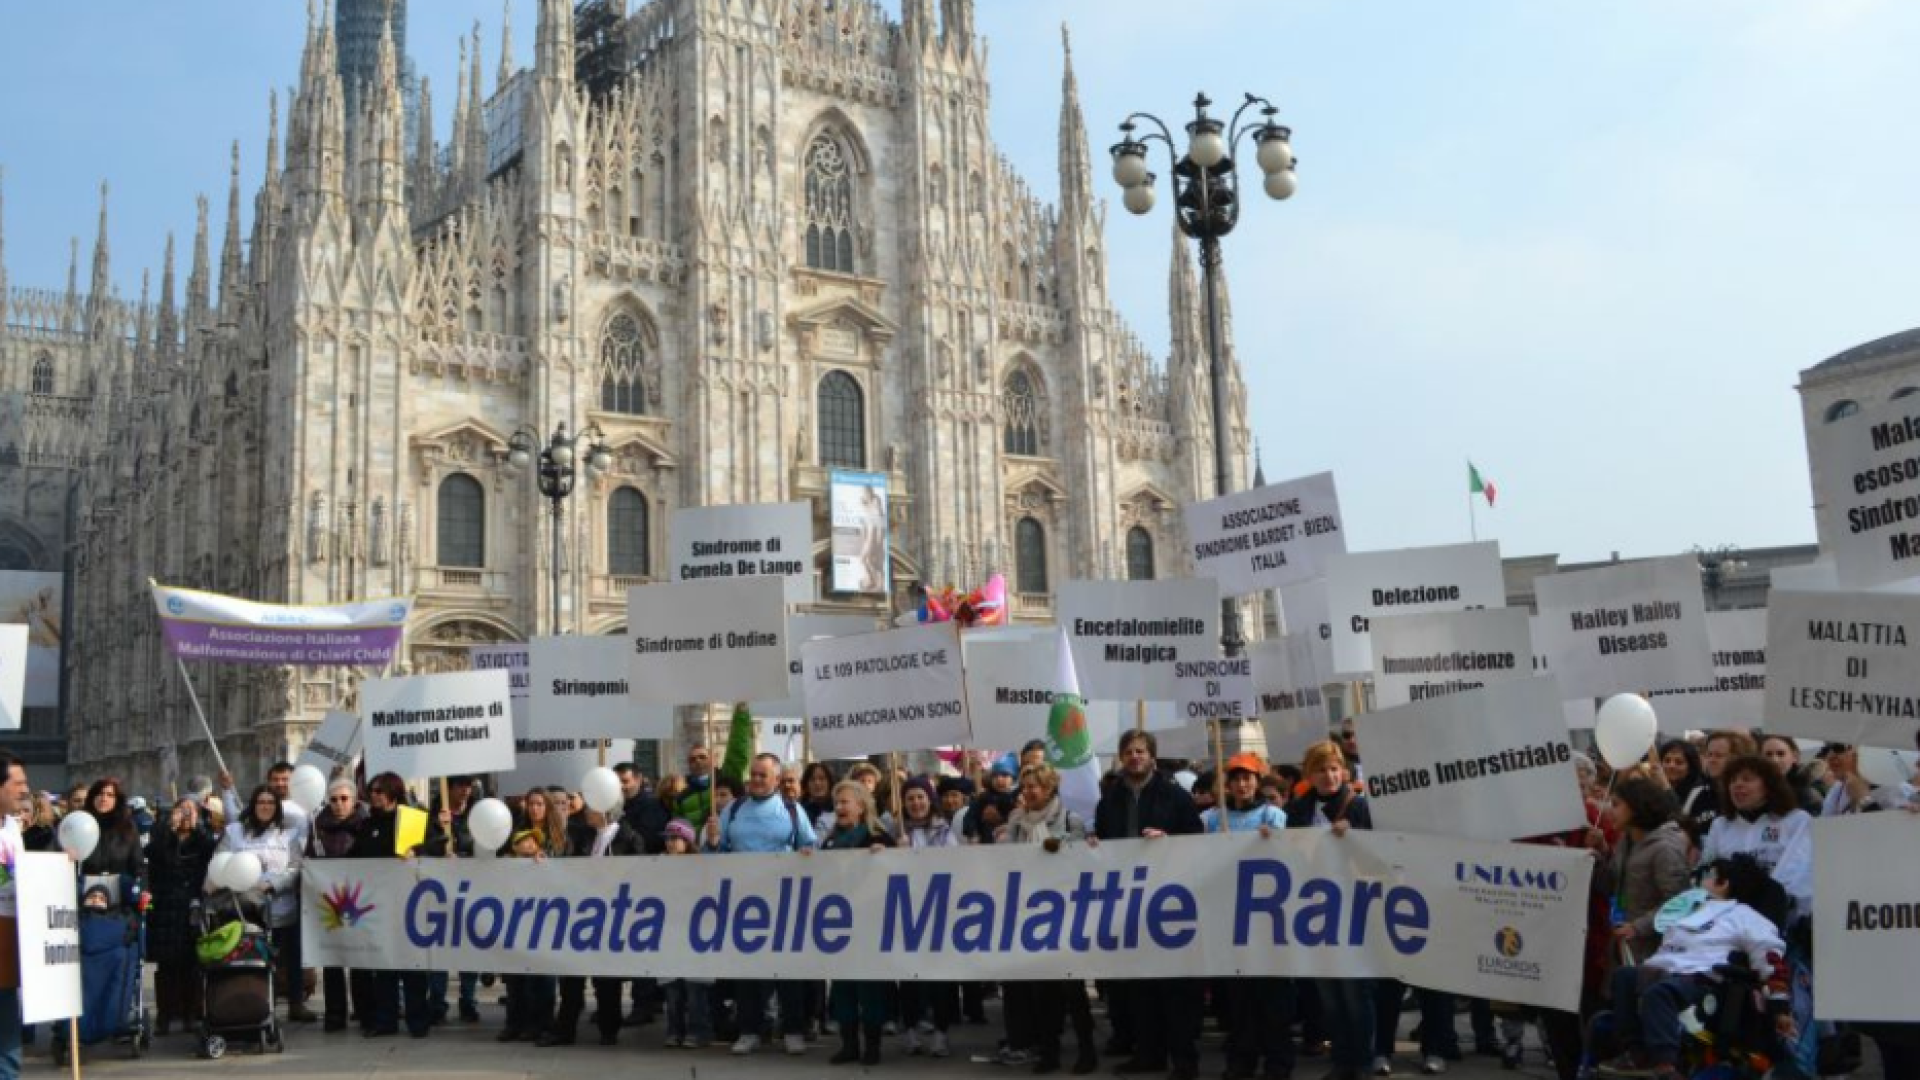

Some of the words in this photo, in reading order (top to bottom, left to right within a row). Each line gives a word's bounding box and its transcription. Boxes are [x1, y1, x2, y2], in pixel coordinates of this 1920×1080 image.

[1222, 498, 1301, 529] ASSOCIAZIONE
[692, 538, 762, 557] Sindrome
[766, 536, 781, 550] di
[1195, 533, 1251, 560] SINDROME
[1252, 524, 1295, 547] BARDET
[738, 559, 756, 575] De
[760, 558, 803, 576] Lange
[1251, 551, 1287, 572] ITALIA
[1372, 584, 1460, 606] Delezione
[1075, 618, 1205, 637] Encefalomielite
[1570, 608, 1628, 631] Hailey
[1631, 601, 1681, 623] Hailey
[208, 626, 305, 645] Associazione
[306, 631, 361, 646] Italiana
[636, 635, 704, 654] Sindrome
[708, 632, 722, 648] di
[726, 630, 777, 648] Ondine
[1599, 631, 1668, 655] Disease
[1808, 620, 1907, 646] MALATTIA
[178, 642, 286, 661] Malformazione
[290, 650, 304, 661] di
[307, 650, 351, 662] Chiari
[353, 648, 391, 661] Child
[1104, 643, 1177, 663] Mialgica
[1383, 651, 1515, 674] Immunodeficienze
[815, 665, 831, 680] LE
[835, 660, 853, 677] 109
[855, 654, 920, 675] PATOLOGIE
[924, 650, 948, 665] CHE
[1175, 660, 1250, 678] SINDROME
[1847, 657, 1868, 678] DI
[1206, 681, 1221, 696] DI
[372, 704, 484, 727] Malformazione
[488, 701, 503, 717] di
[813, 716, 845, 731] RARE
[848, 708, 897, 727] ANCORA
[900, 704, 925, 720] NON
[927, 700, 962, 718] SONO
[1187, 701, 1242, 716] ONDINE
[390, 728, 439, 748] Arnold
[444, 724, 489, 743] Chiari
[1367, 768, 1431, 799] Cistite
[1434, 741, 1571, 785] Interstiziale
[404, 879, 666, 950] Giornata
[689, 877, 853, 954] delle
[880, 867, 1198, 953] Malattie
[1233, 859, 1430, 955] Rare
